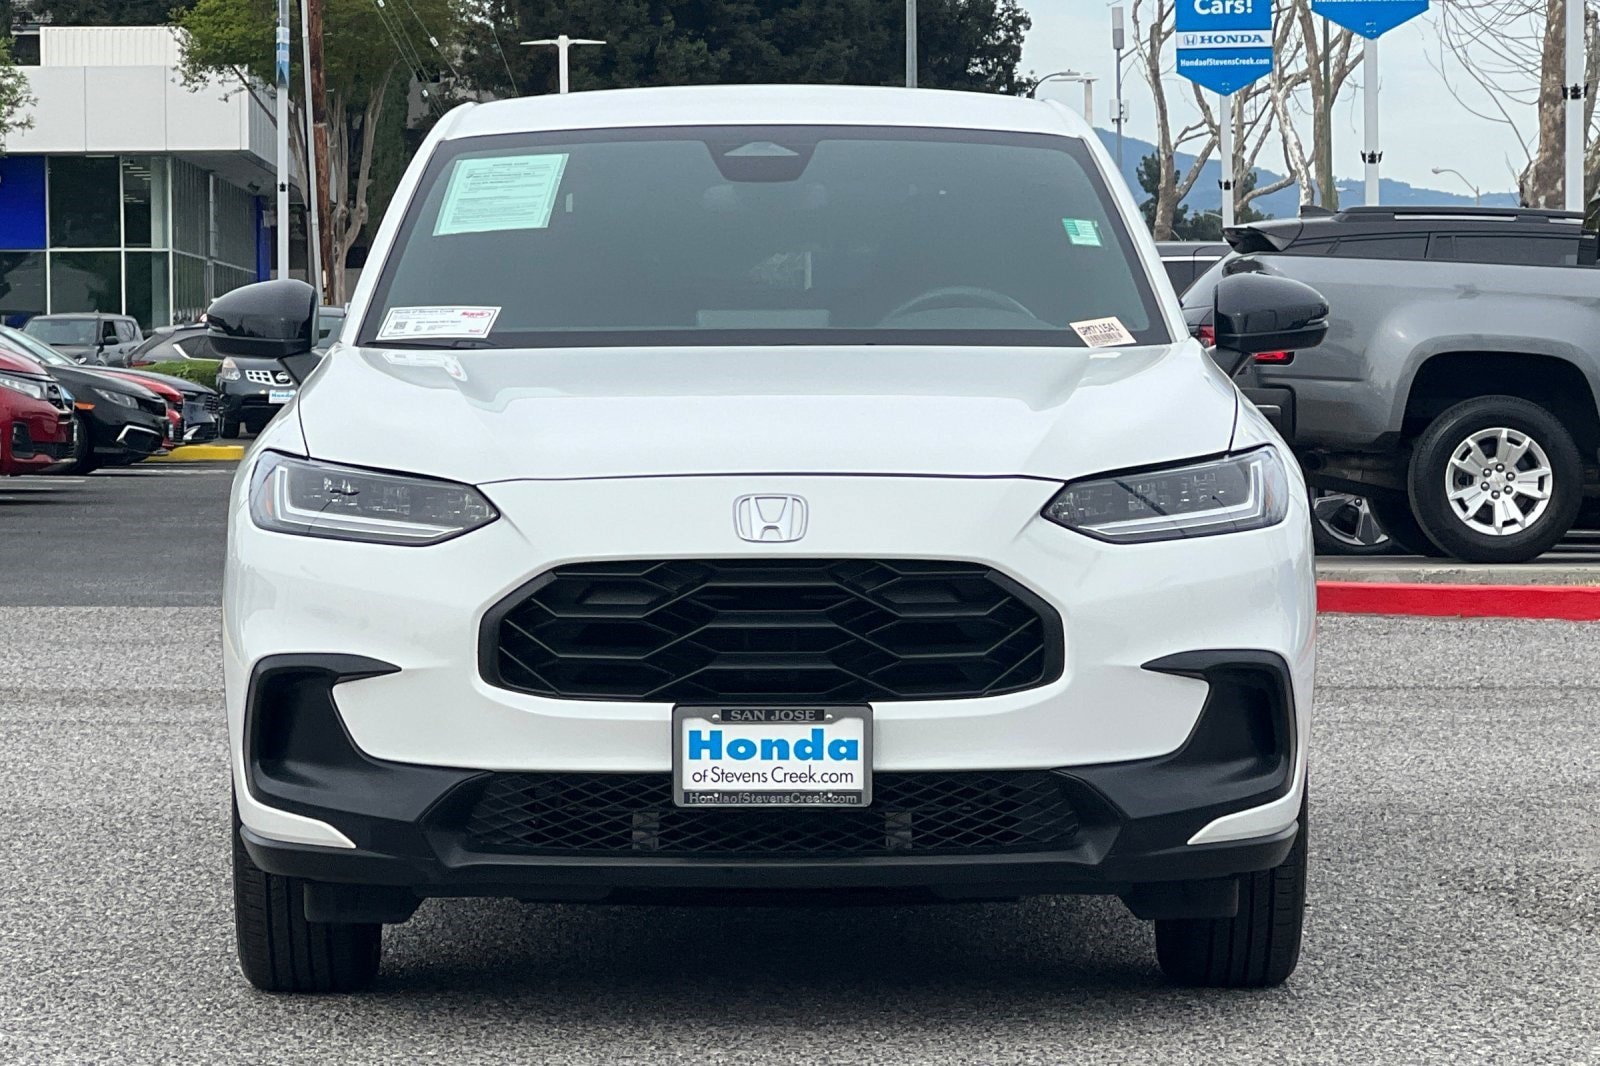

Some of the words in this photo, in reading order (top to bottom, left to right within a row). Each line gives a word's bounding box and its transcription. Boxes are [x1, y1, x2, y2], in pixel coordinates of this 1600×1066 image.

[1193, 0, 1253, 15] Cars!
[1199, 34, 1265, 44] HONDA
[1180, 57, 1270, 67] HondaofStevensCreek.com
[730, 710, 766, 721] SAN
[770, 710, 816, 721] JOSE
[688, 728, 859, 761] Honda
[692, 768, 708, 783] of
[710, 766, 768, 784] Stevens
[771, 765, 854, 784] Creek.com
